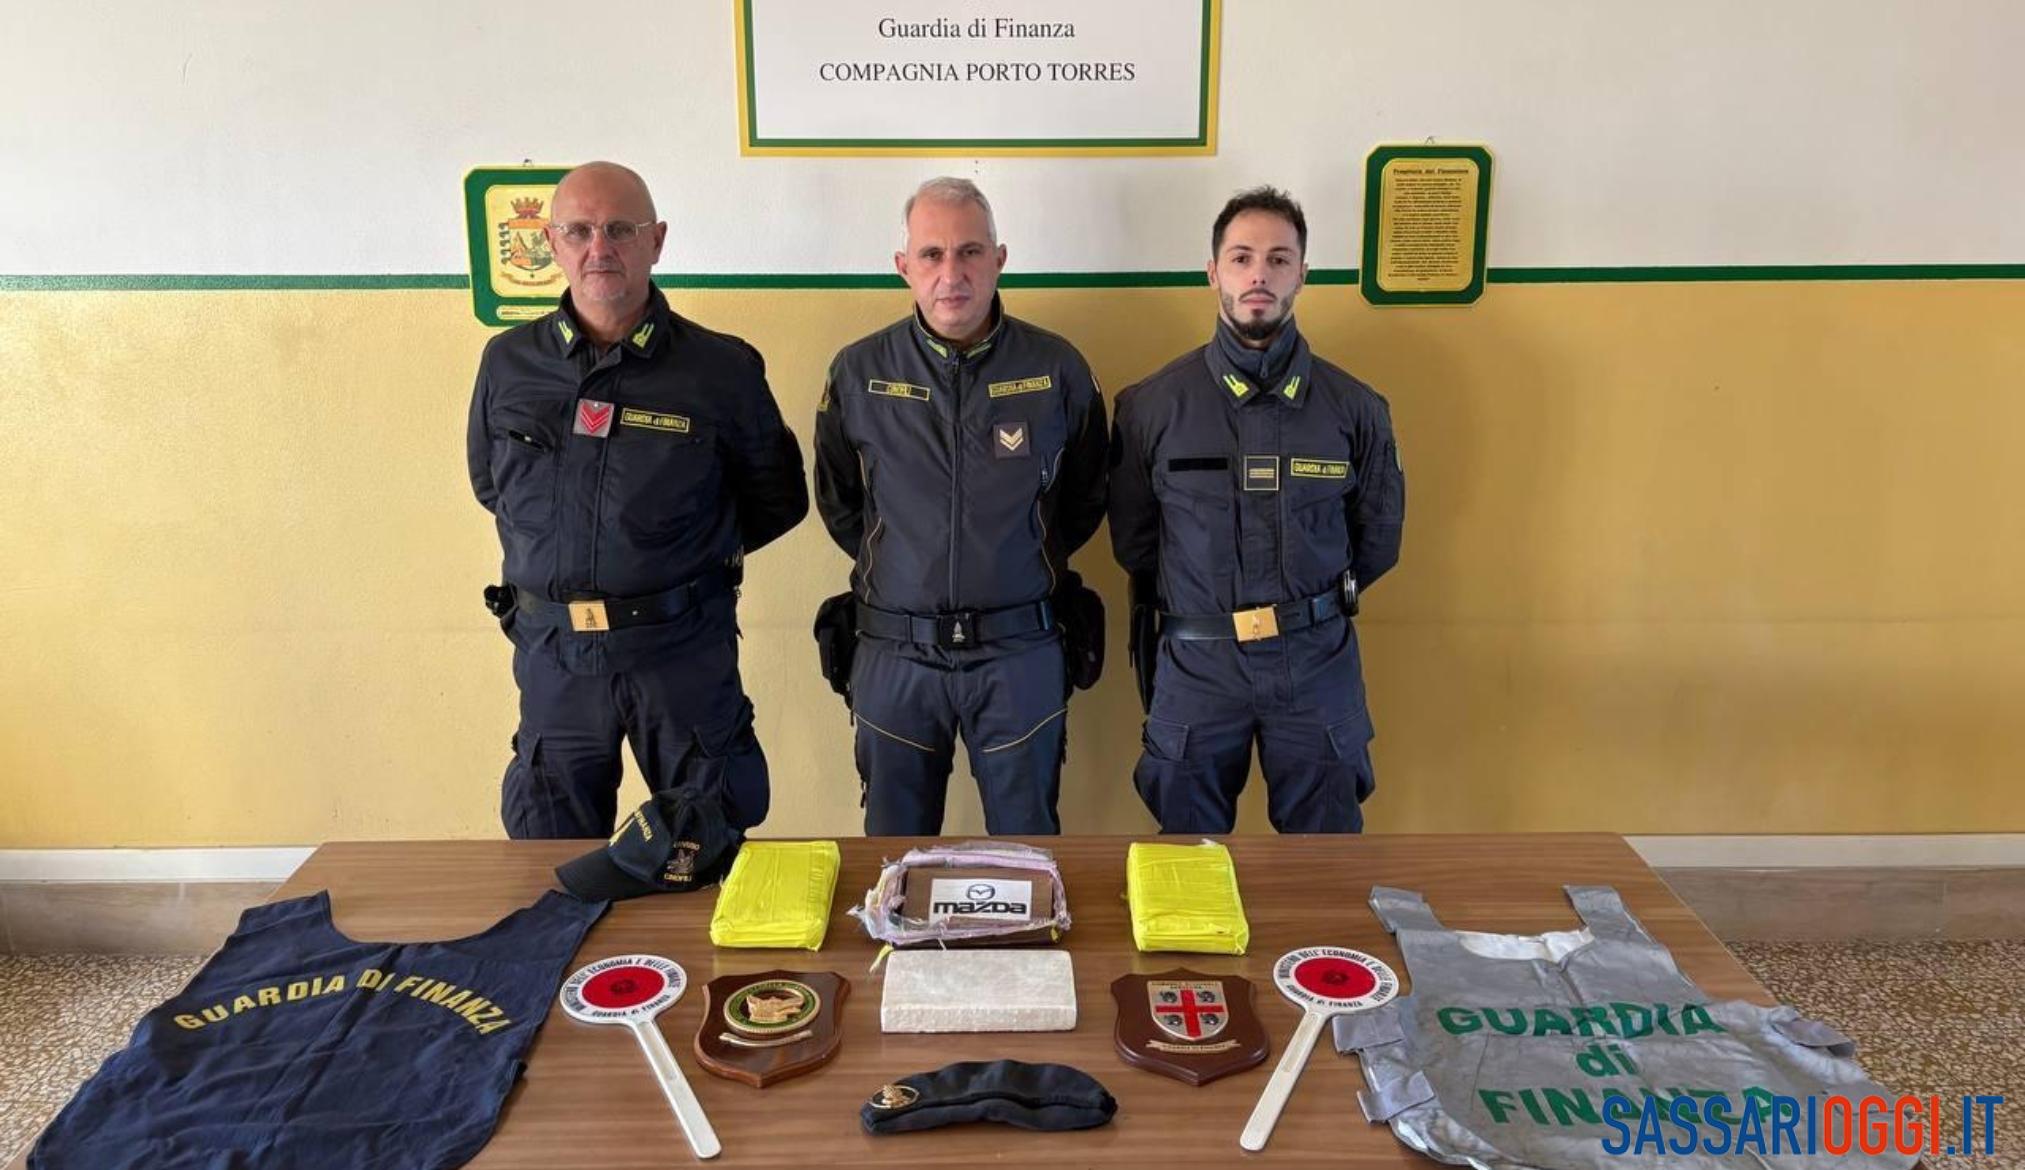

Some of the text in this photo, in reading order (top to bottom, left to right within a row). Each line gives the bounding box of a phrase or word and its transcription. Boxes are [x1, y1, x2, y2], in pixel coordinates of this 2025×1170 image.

[877, 17, 1075, 39] Guardia di Finanza
[819, 63, 1136, 82] COMPAGNIA PORTO TORRES
[173, 968, 513, 1036] GUARDIA DI FINANZA
[1436, 1001, 1728, 1039] GUARDIA
[1575, 1042, 1638, 1078] di
